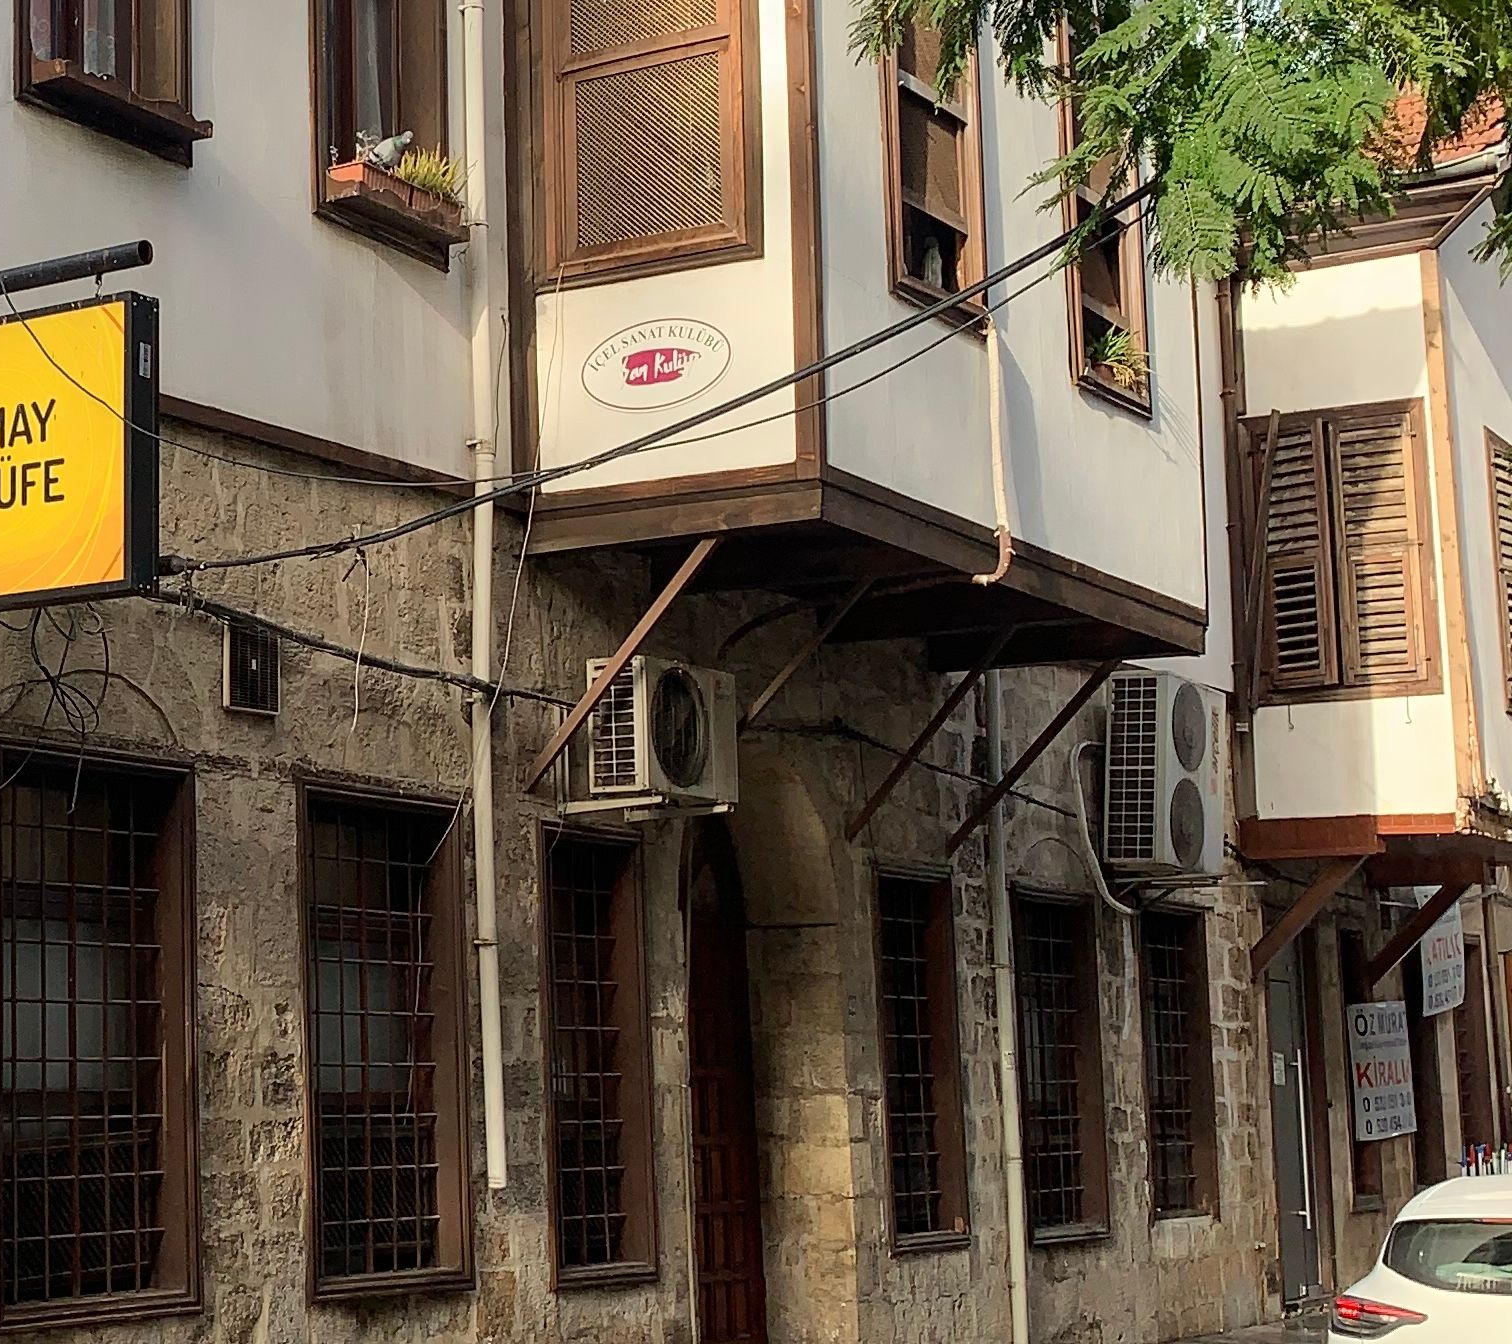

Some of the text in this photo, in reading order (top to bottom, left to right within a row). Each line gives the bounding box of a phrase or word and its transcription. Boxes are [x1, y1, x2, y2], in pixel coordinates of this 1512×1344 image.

[588, 325, 725, 372] İÇEL SANAT KULÜBÜ
[1355, 1008, 1406, 1037] ÖZ MURA
